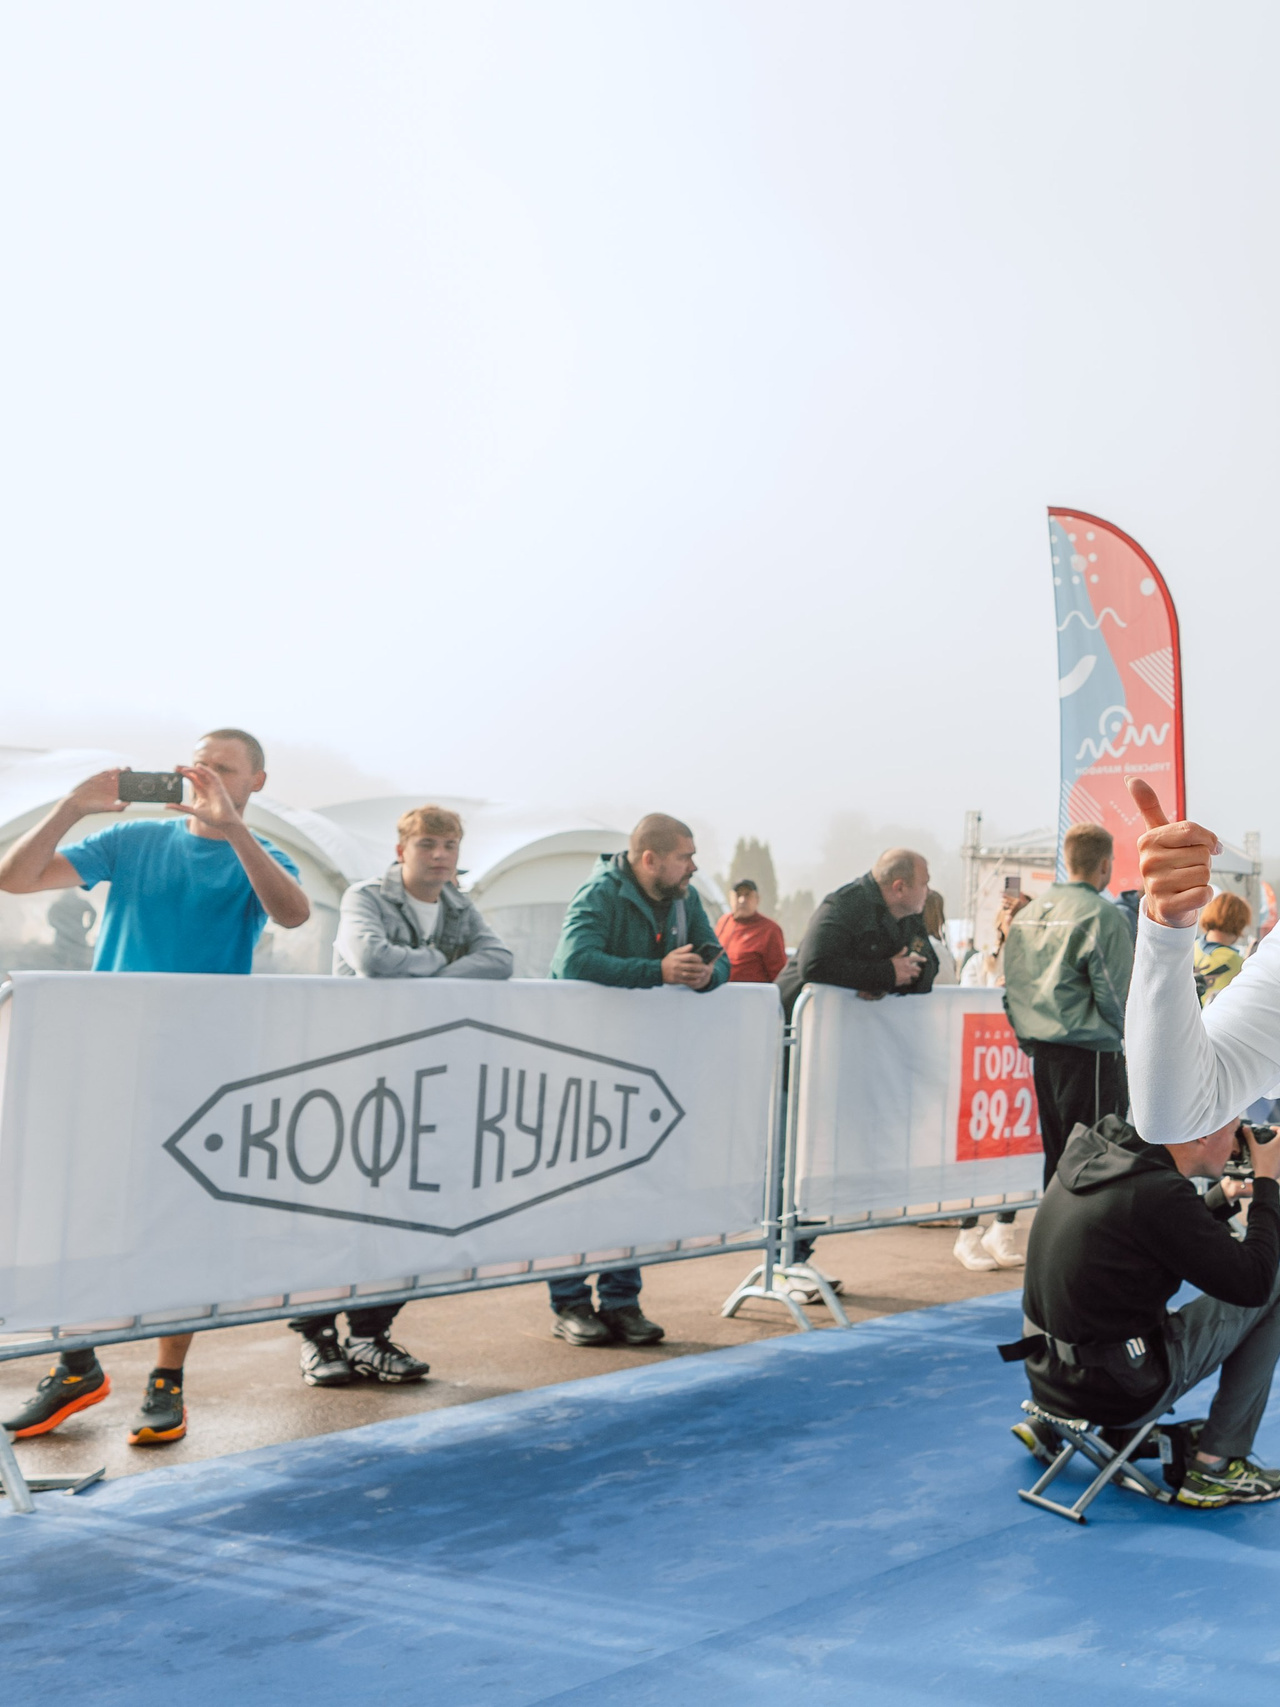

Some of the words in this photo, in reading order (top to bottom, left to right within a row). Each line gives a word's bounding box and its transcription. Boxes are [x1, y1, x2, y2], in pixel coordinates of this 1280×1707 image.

[239, 1064, 448, 1193] КОФЕ
[472, 1063, 640, 1190] КУЛЬТ
[968, 1087, 1033, 1141] 89.2
